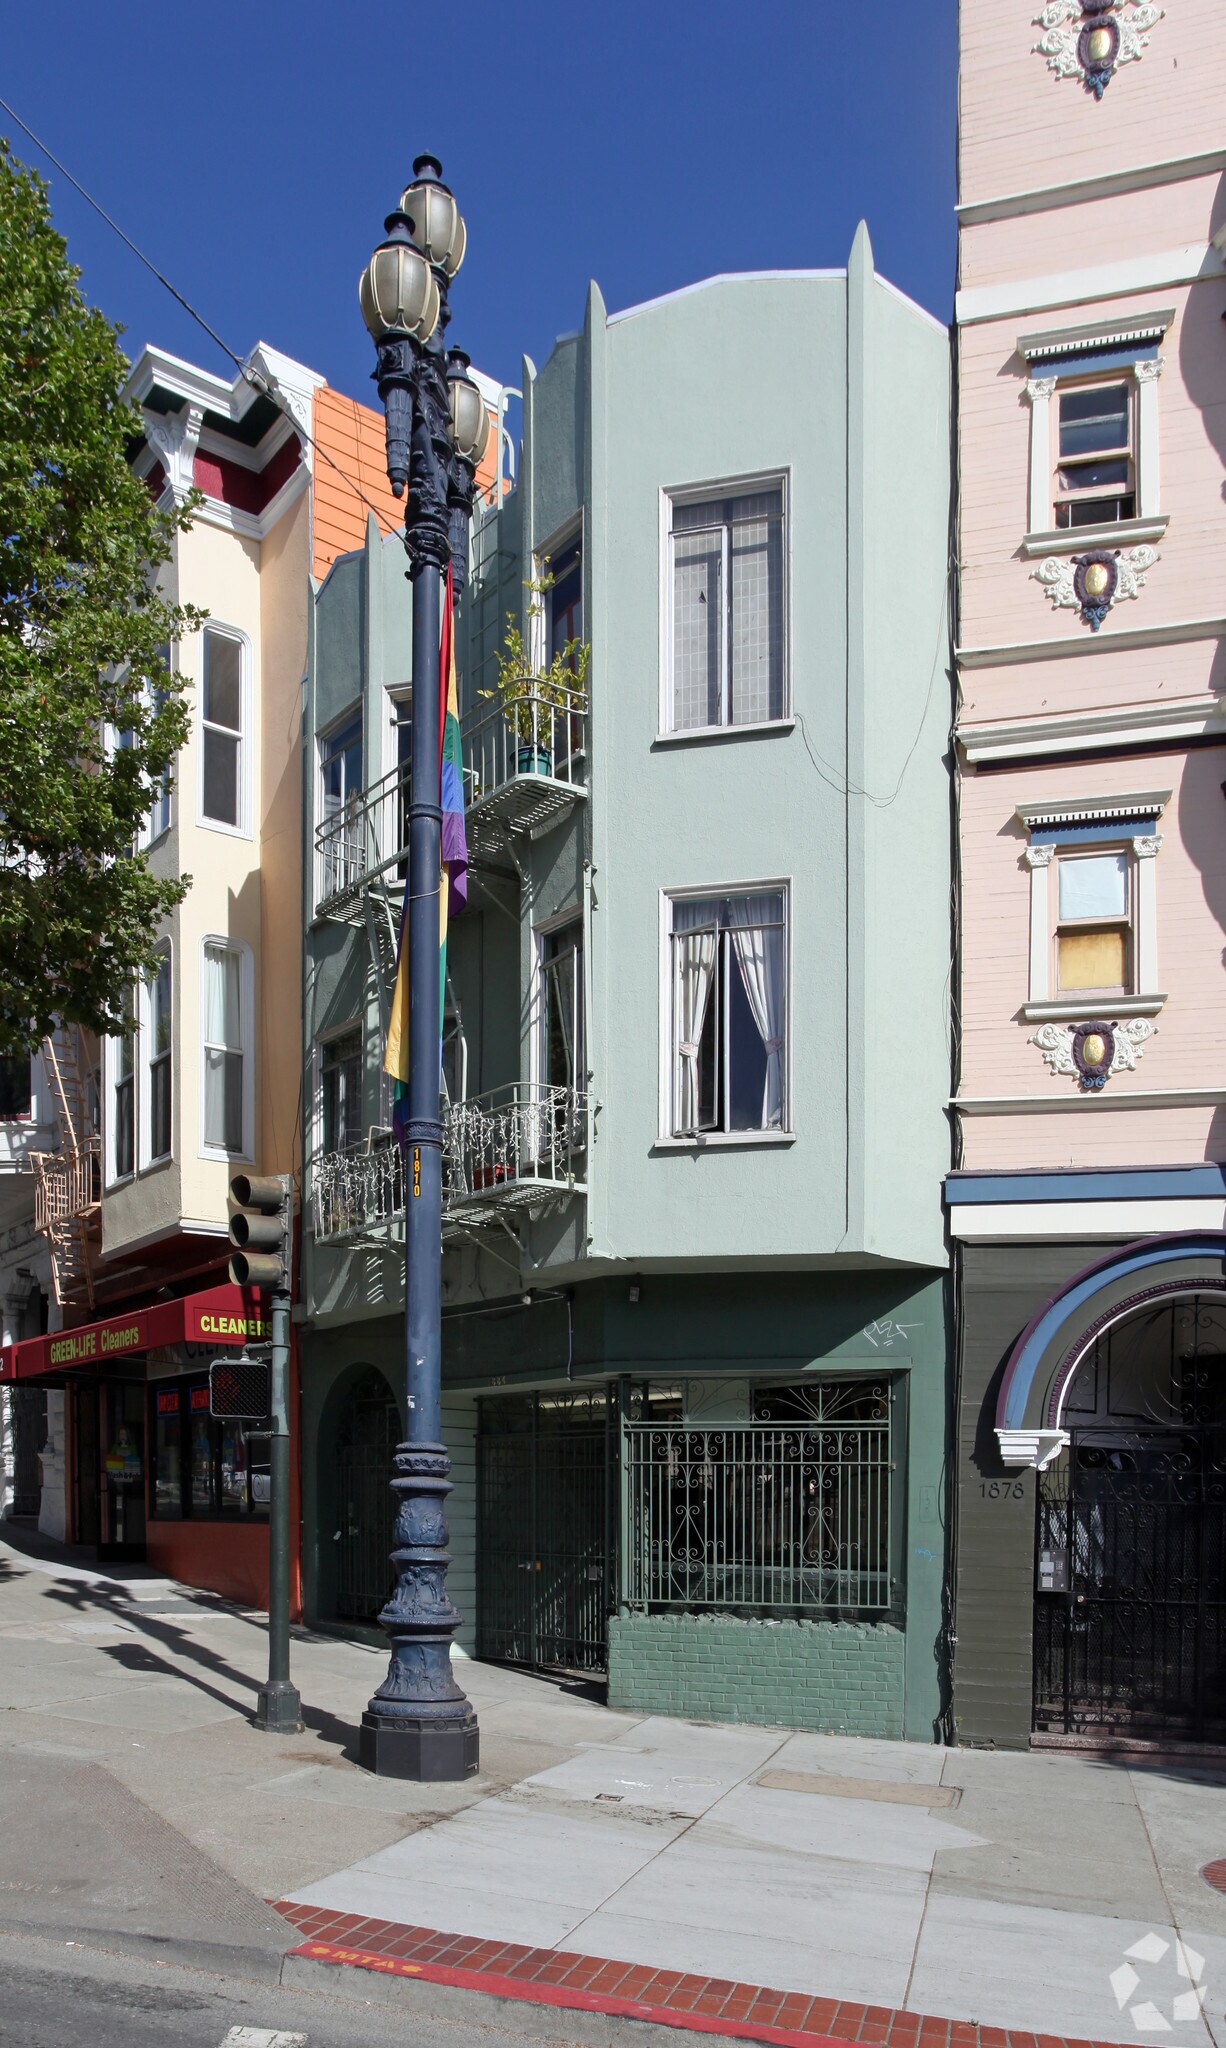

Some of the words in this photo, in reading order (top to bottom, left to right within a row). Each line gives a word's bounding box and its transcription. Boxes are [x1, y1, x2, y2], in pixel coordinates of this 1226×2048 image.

[200, 1315, 272, 1337] CLEANERS
[50, 1332, 96, 1364] GREEN-LIFE
[101, 1326, 139, 1352] Cleaners
[978, 1481, 1025, 1500] 1878
[331, 1950, 395, 1969] MTA
